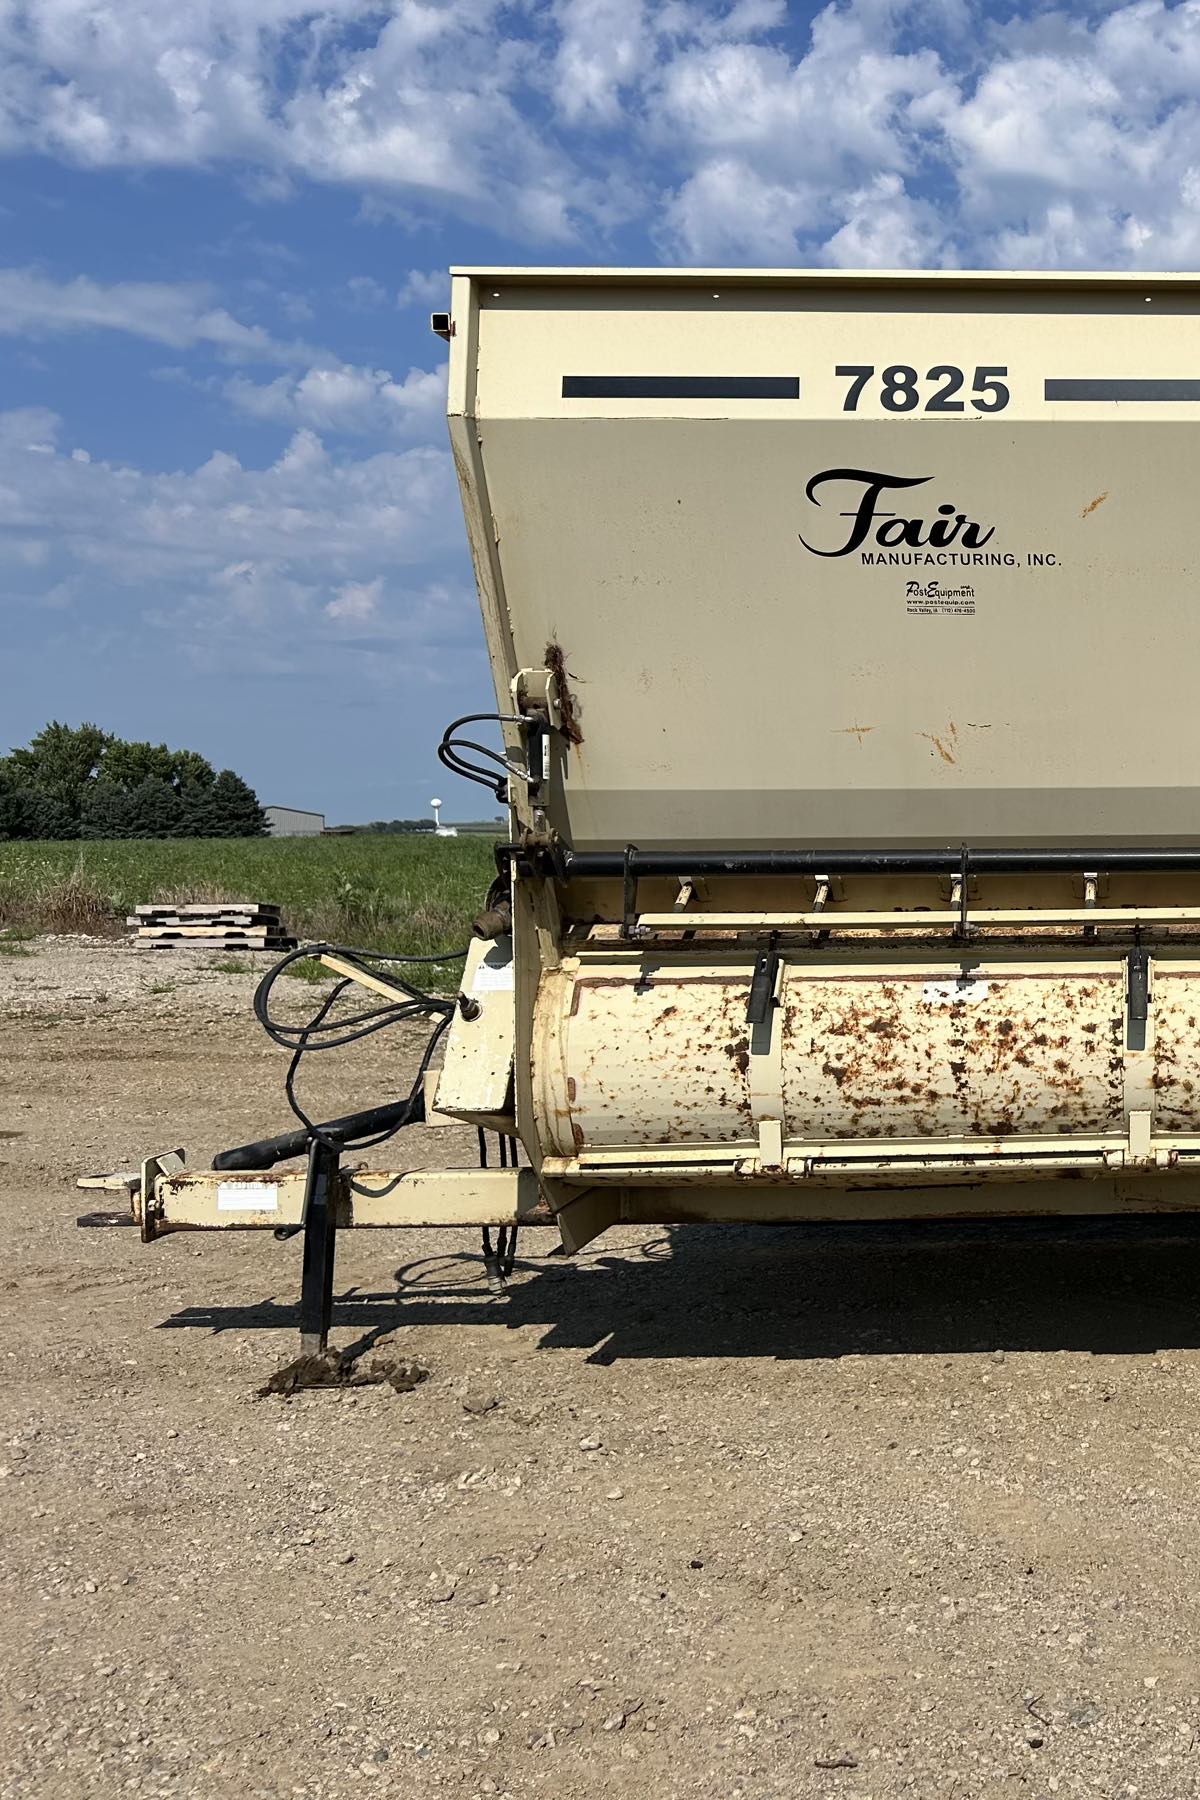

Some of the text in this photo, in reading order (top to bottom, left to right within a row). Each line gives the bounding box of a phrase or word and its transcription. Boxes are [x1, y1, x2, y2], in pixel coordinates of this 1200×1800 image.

[835, 365, 1010, 412] 7825
[799, 468, 996, 557] Fair
[861, 553, 1062, 568] MANUFACTURING, INC.
